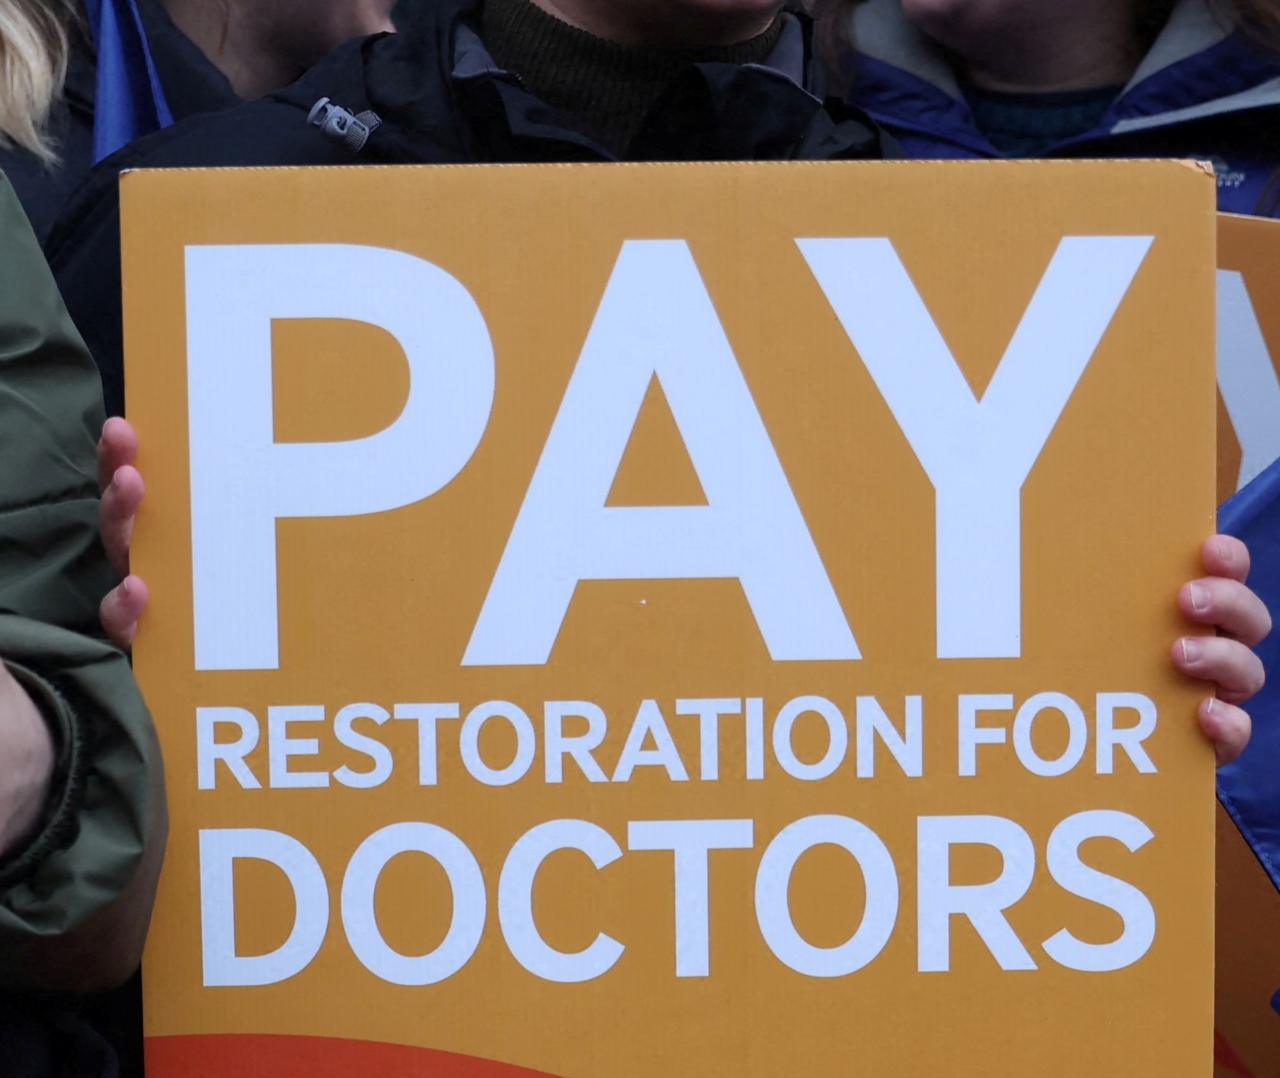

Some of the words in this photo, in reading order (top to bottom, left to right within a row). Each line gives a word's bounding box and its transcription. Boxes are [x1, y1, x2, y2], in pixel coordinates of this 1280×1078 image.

[184, 235, 1154, 670] PAY
[195, 694, 924, 790] RESTORATION
[958, 691, 1158, 777] FOR
[199, 809, 1157, 987] DOCTORS
